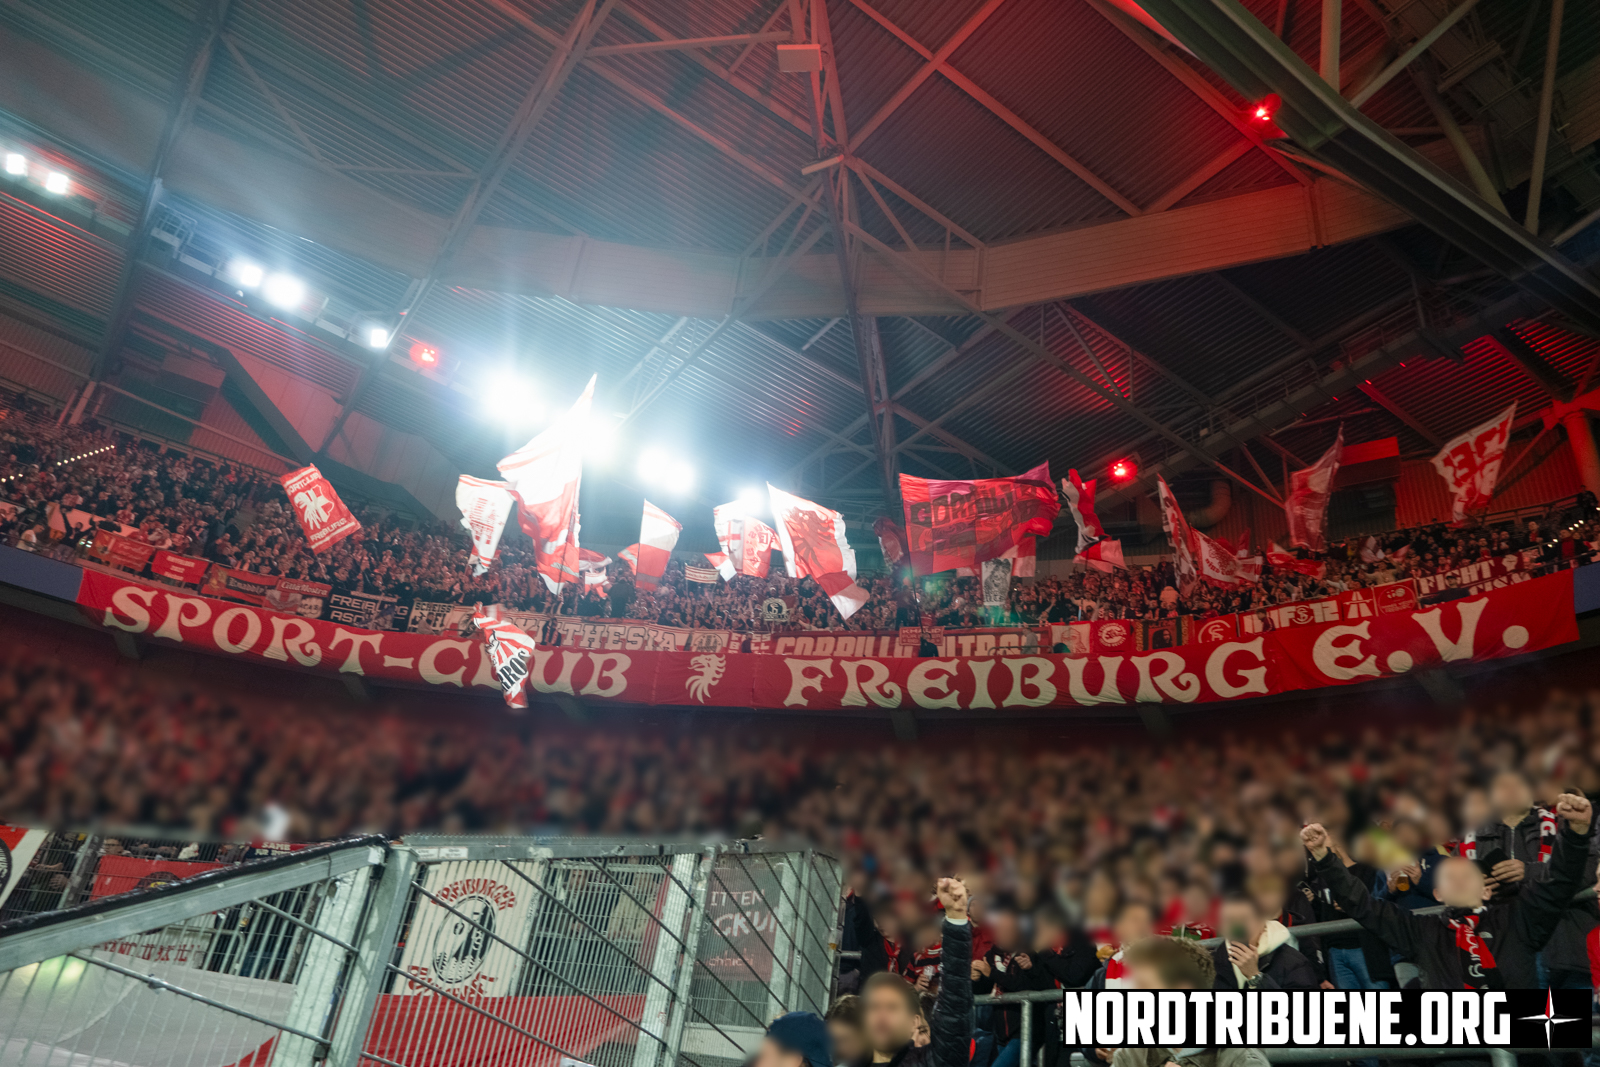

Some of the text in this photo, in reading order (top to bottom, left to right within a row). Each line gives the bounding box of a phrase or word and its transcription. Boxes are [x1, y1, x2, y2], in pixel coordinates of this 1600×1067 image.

[1420, 560, 1495, 594] FIGHT
[415, 601, 453, 613] SCHEISS
[729, 641, 770, 651] BLL
[782, 636, 1269, 710] FREIBURG
[1312, 597, 1530, 680] E.V.
